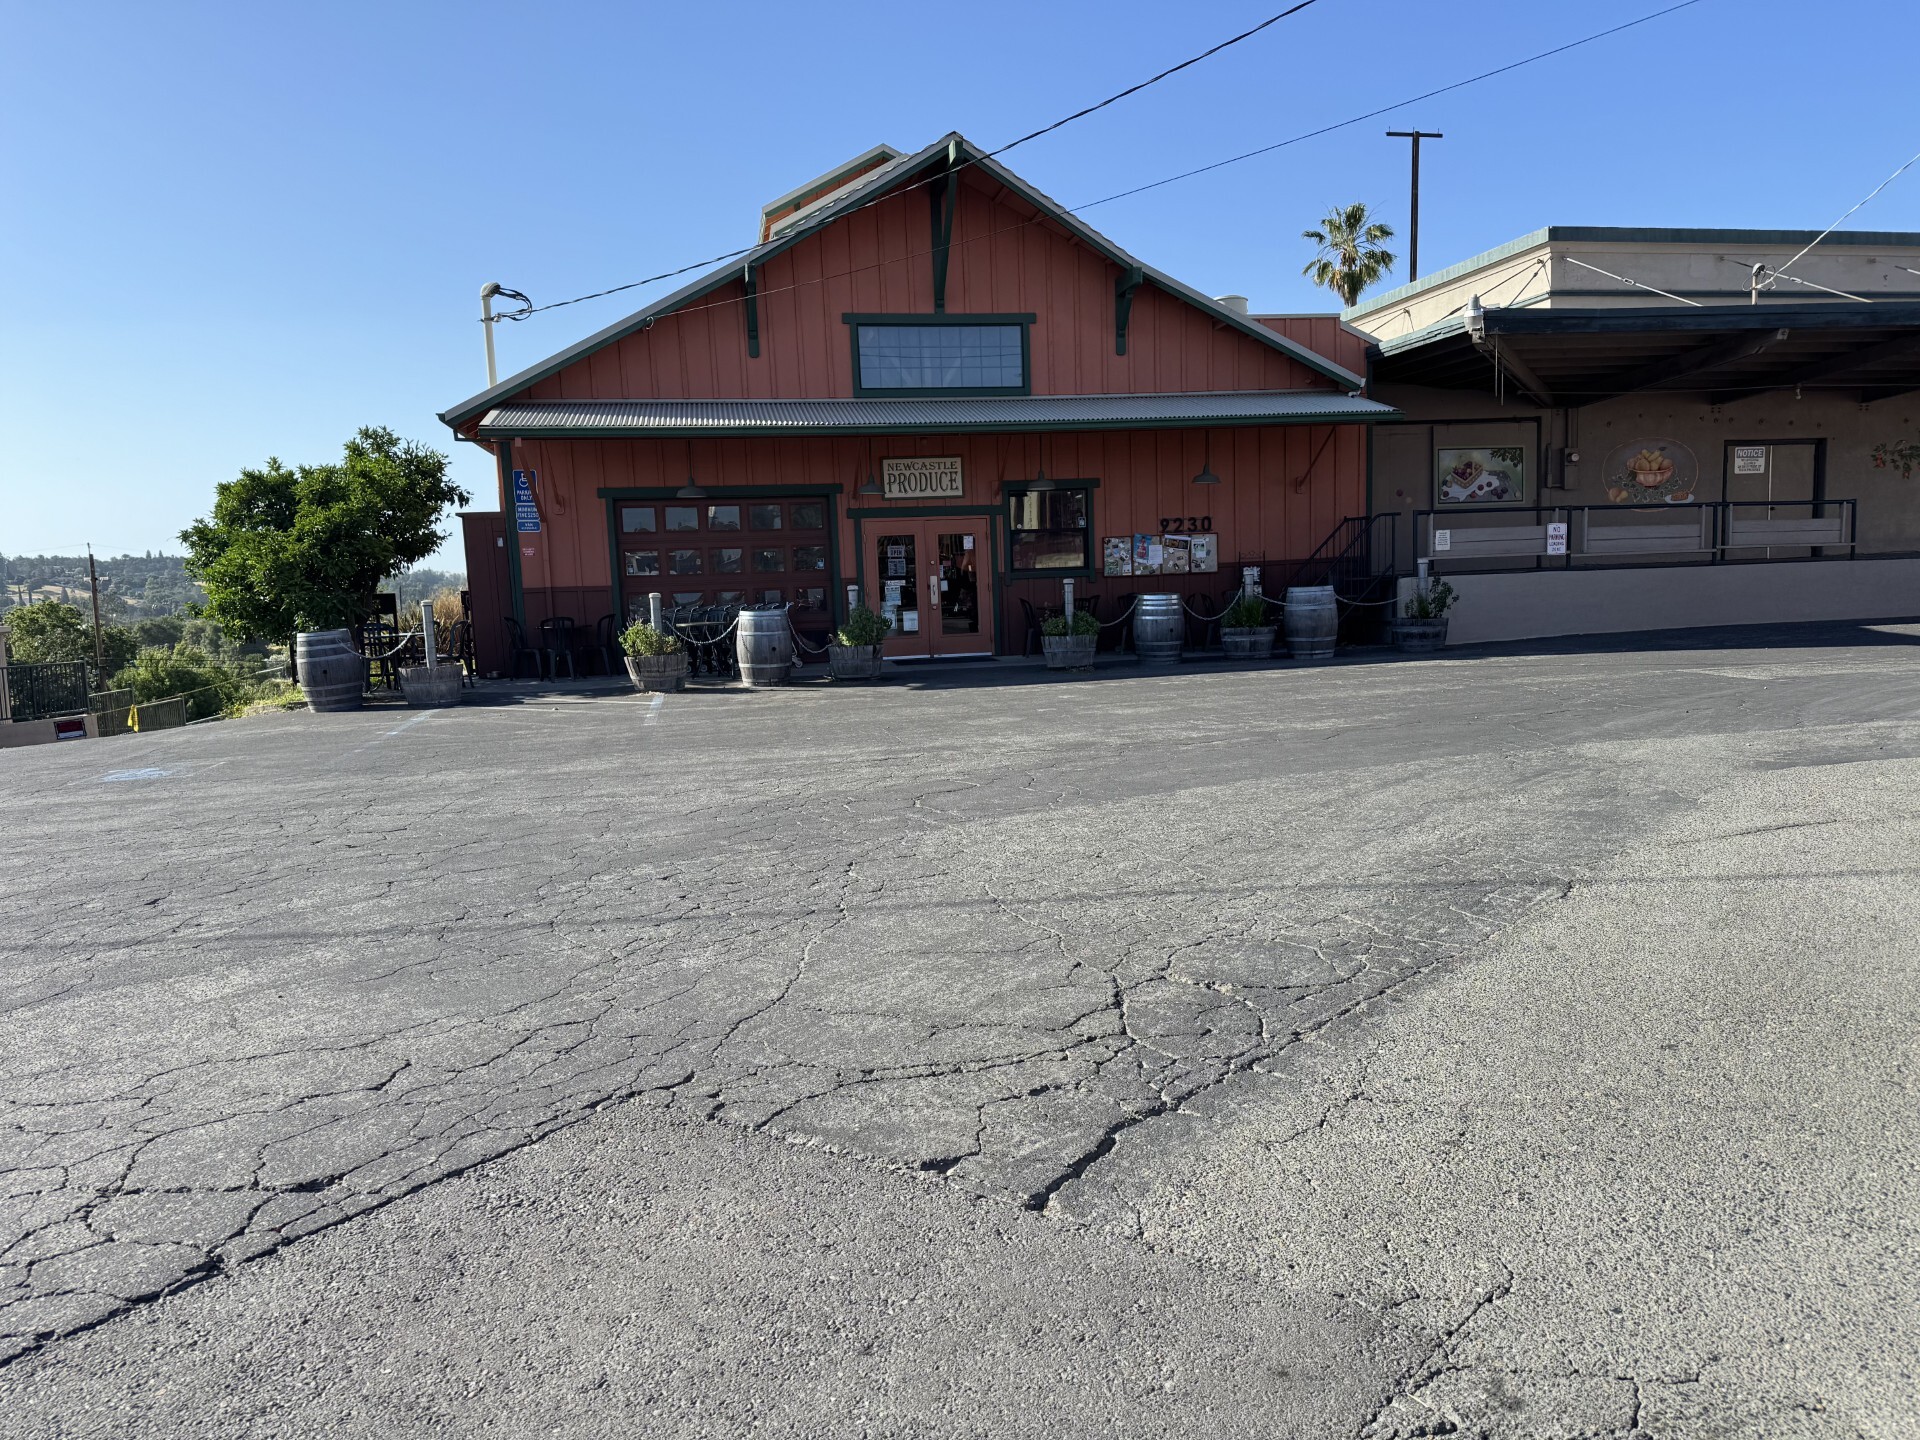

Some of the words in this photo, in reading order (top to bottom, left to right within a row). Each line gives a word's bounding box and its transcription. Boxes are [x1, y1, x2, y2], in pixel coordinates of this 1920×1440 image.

[1737, 449, 1763, 457] NOTICE
[887, 461, 958, 471] NEWCASTLE
[886, 471, 959, 494] PRODUCE
[1160, 516, 1212, 533] 9230
[1548, 533, 1565, 541] PARKING
